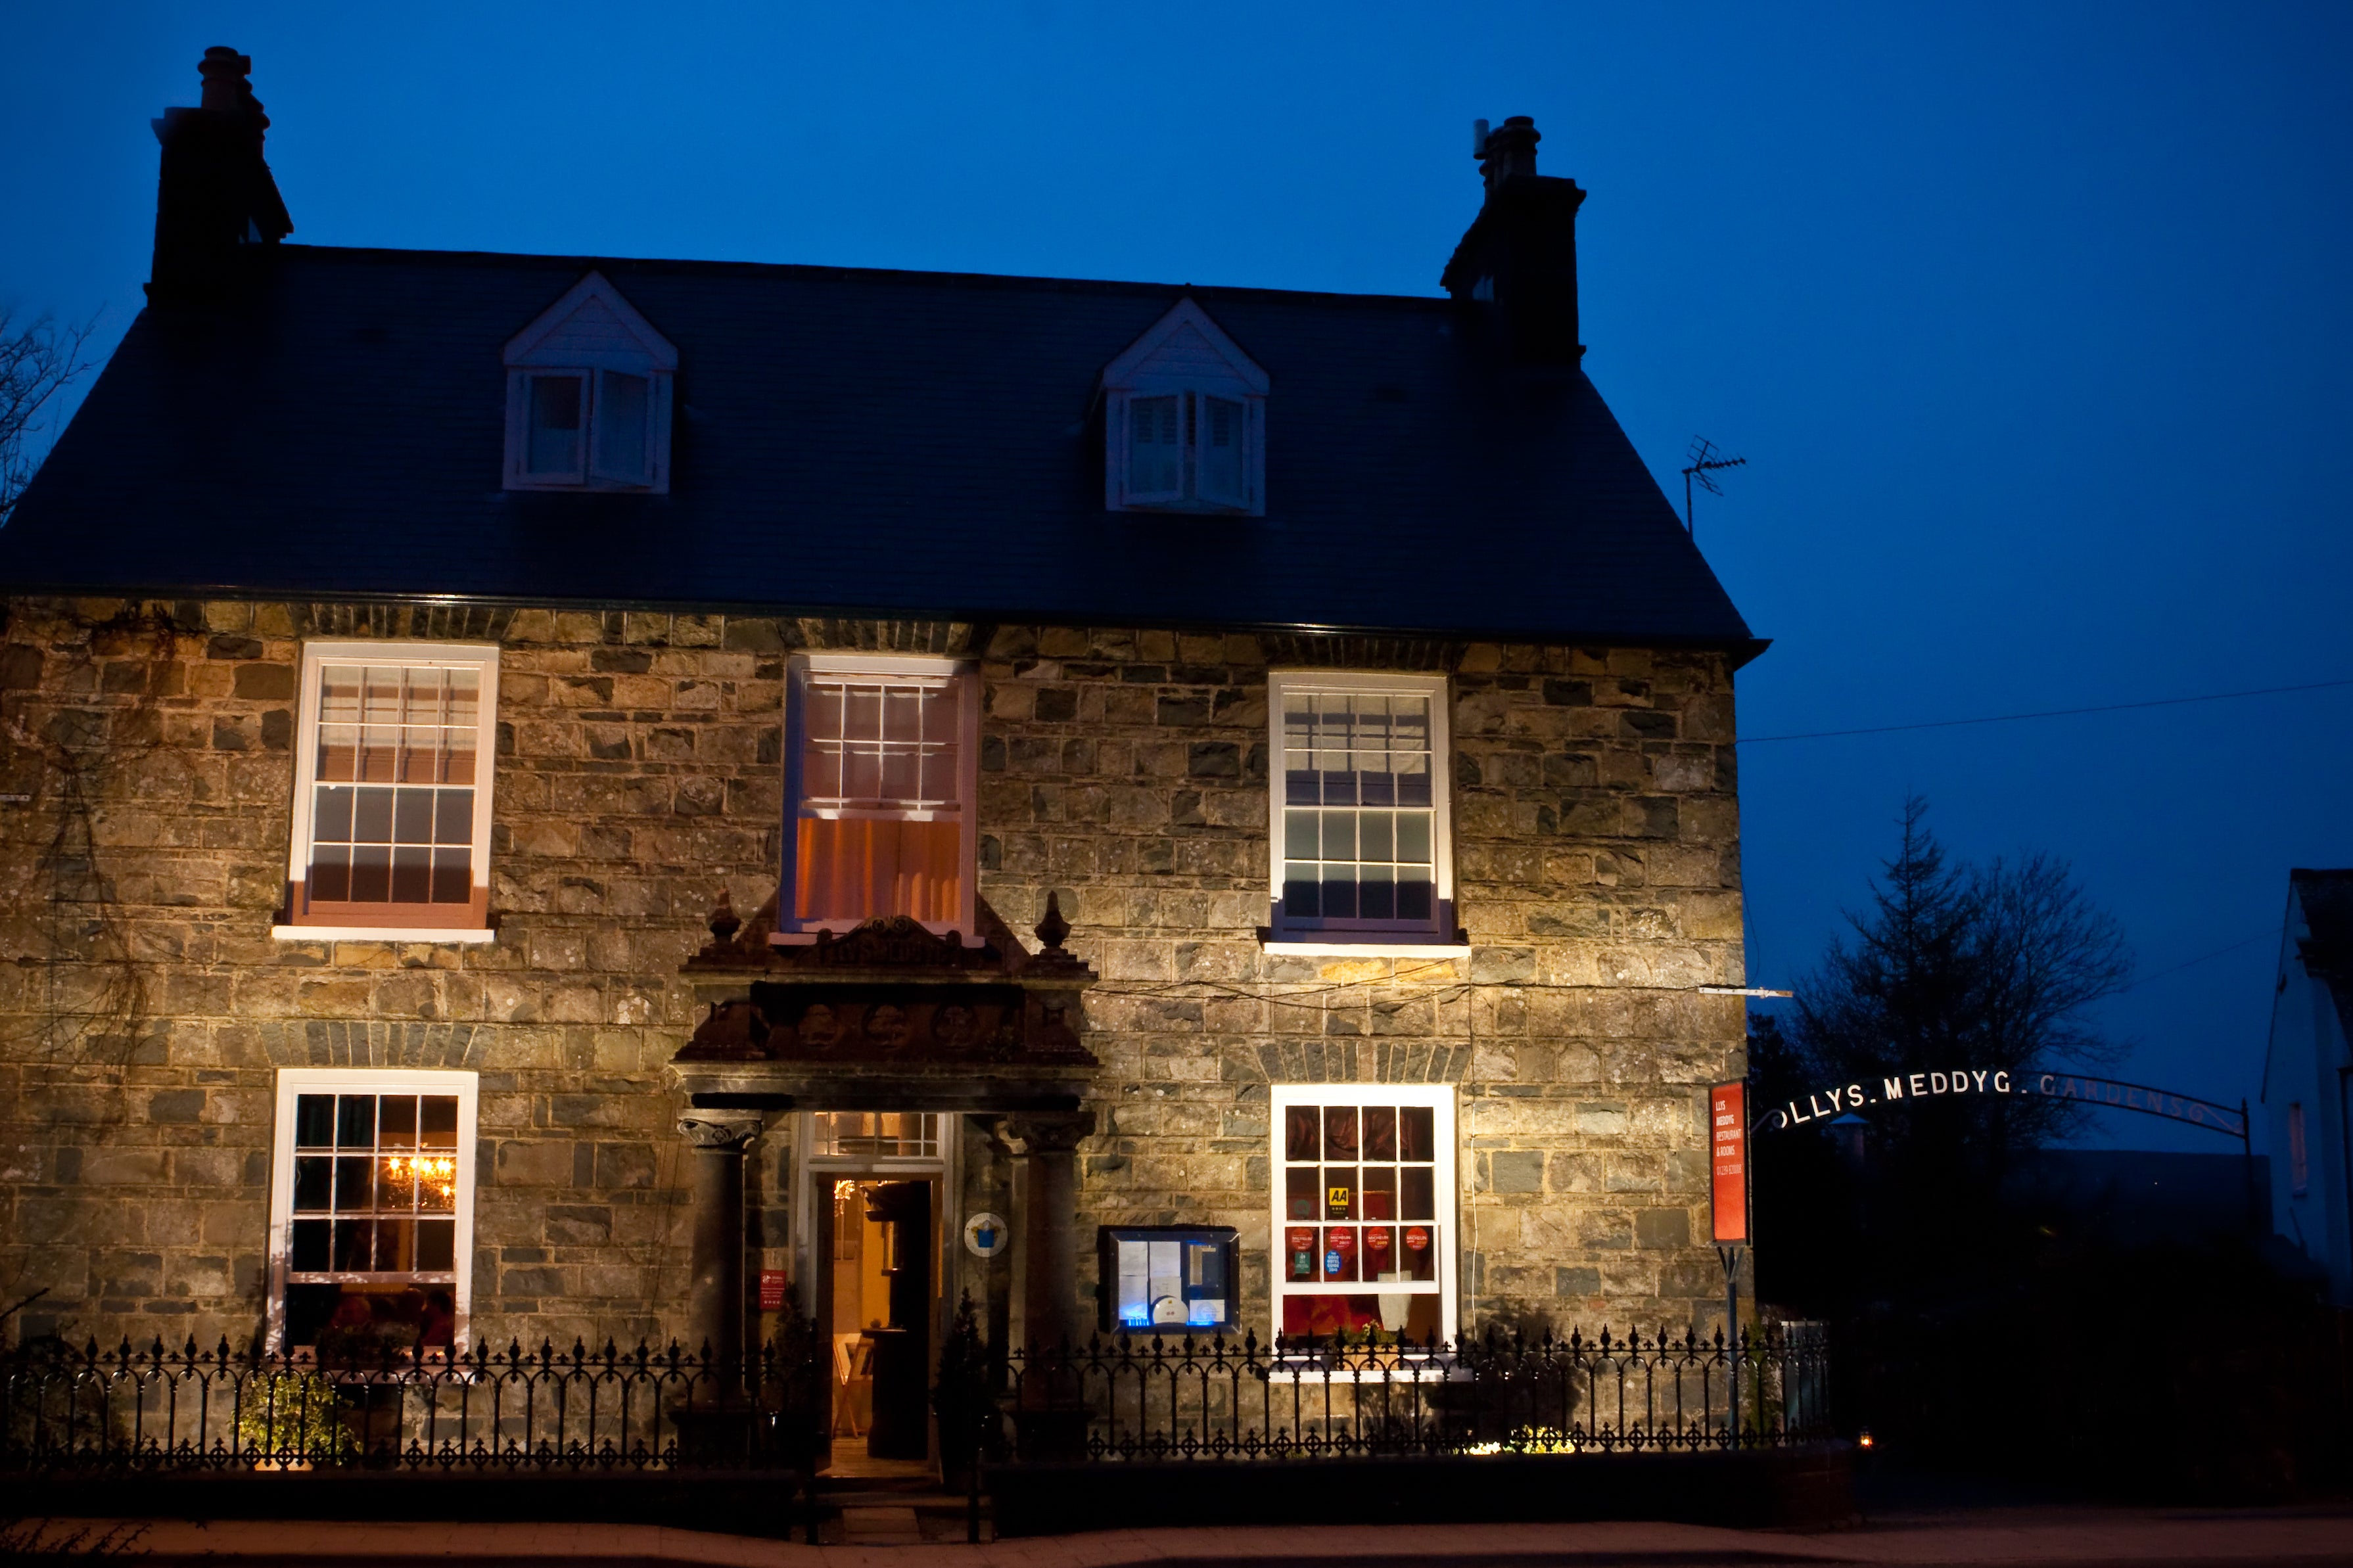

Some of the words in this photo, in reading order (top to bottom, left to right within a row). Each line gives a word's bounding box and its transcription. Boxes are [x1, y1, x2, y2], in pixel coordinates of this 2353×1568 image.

[2039, 1074, 2184, 1118] GARDENS
[1715, 1099, 1726, 1111] LLYS
[1716, 1115, 1735, 1126] MEDDYG
[1716, 1128, 1742, 1141] RESTAURANT
[1720, 1145, 1735, 1157] ROOMS
[1331, 1189, 1347, 1202] AA
